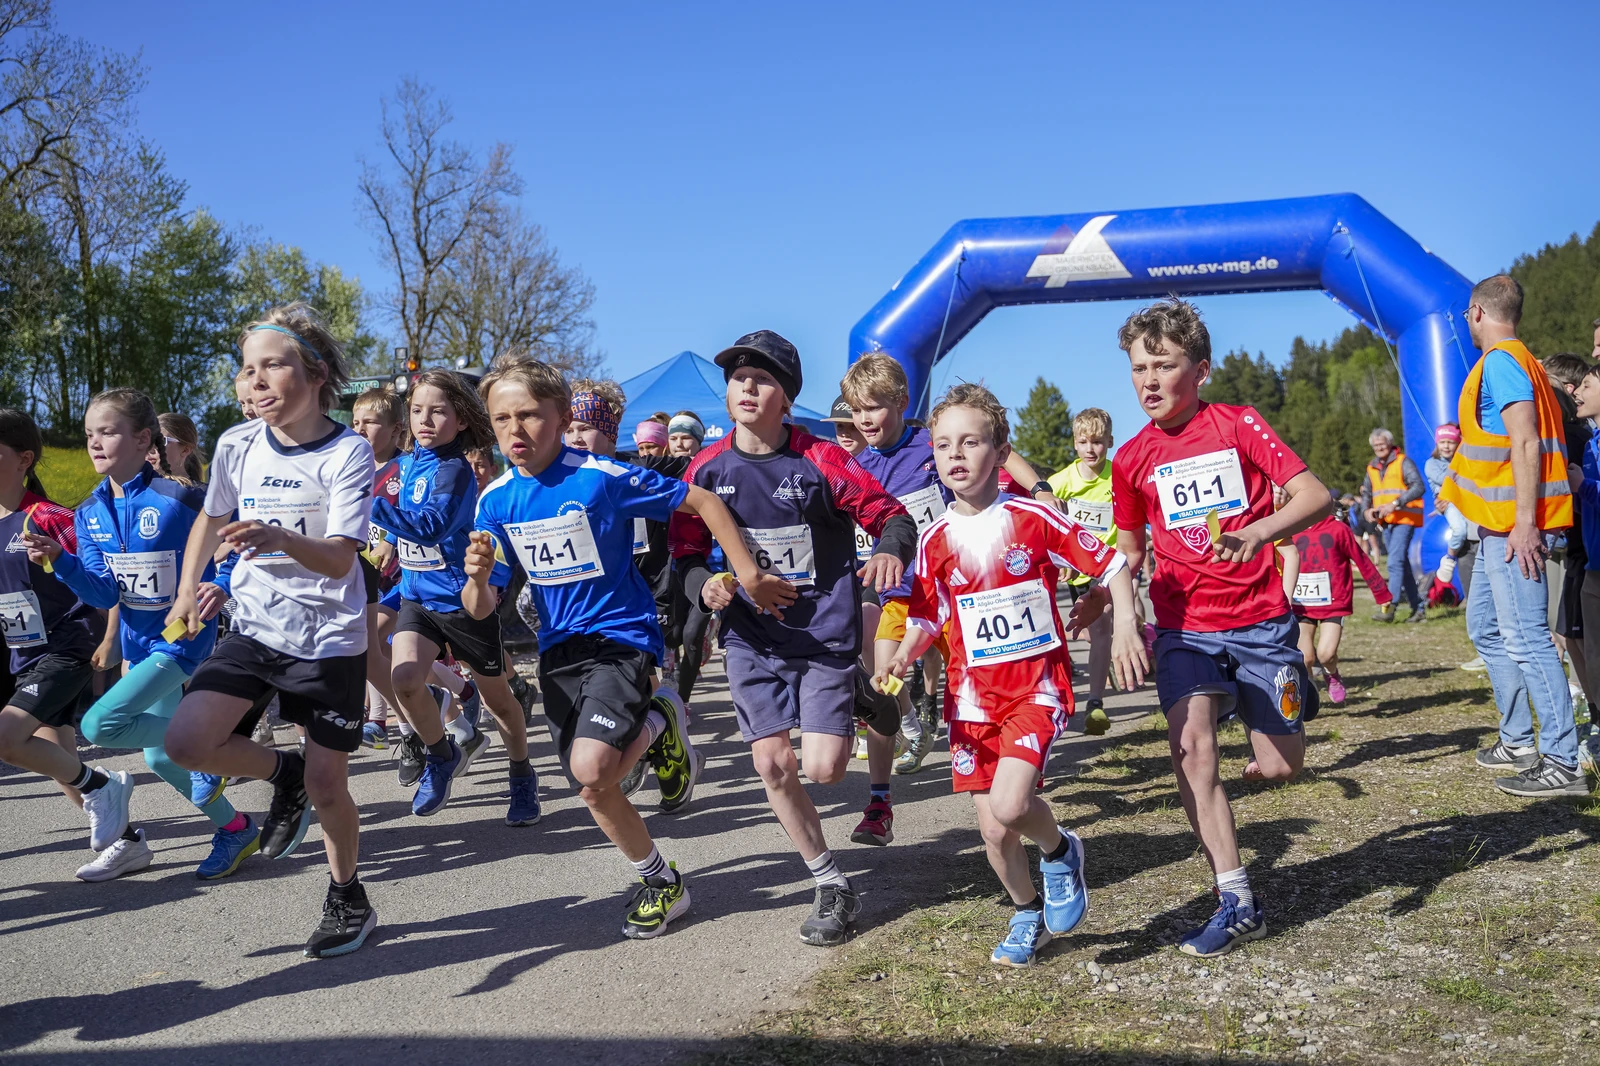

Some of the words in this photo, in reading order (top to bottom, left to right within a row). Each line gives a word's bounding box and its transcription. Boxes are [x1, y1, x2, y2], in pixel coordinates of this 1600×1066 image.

[1147, 256, 1279, 277] www.sv-mg.de
[1174, 460, 1196, 469] Volksbank
[1175, 460, 1225, 474] Allgäu-Oberschwaben
[260, 476, 302, 488] Zeus
[1173, 474, 1224, 506] 61-1
[142, 513, 156, 527] TVL
[1074, 510, 1102, 524] 47-1
[523, 523, 545, 531] Volksbank
[524, 523, 574, 536] Allgäu-Oberschwaben
[524, 538, 577, 567] 74-1
[748, 548, 794, 570] 6-1
[549, 566, 582, 578] Voralpencup
[116, 572, 158, 593] 67-1
[976, 592, 1002, 601] Volksbank
[1296, 584, 1320, 596] 97-1
[978, 591, 1034, 608] Allgäu-Oberschwaben
[976, 606, 1036, 642] 40-1
[984, 646, 1001, 656] VBAO
[1002, 638, 1040, 652] Voralpencup
[322, 710, 360, 730] Zeus
[590, 714, 616, 729] JAKO
